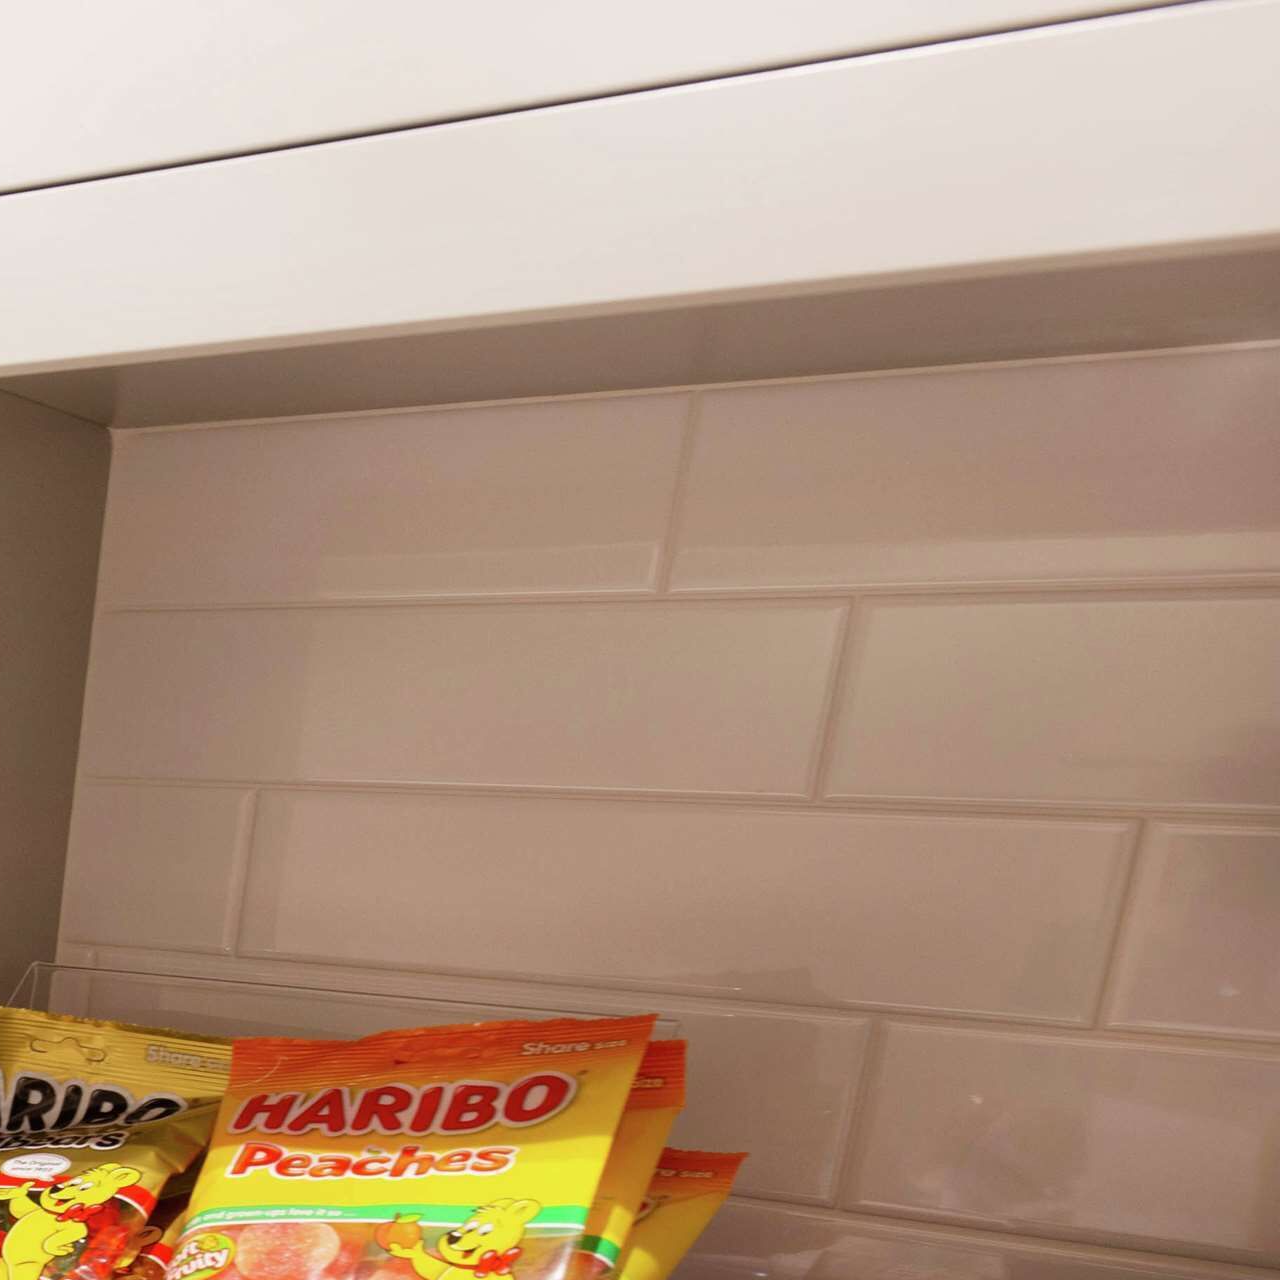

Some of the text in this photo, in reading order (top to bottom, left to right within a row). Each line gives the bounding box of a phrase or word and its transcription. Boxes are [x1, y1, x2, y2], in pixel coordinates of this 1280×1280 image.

[522, 1041, 590, 1055] Share
[232, 1073, 574, 1135] HARIBO
[229, 1143, 516, 1179] Peaches
